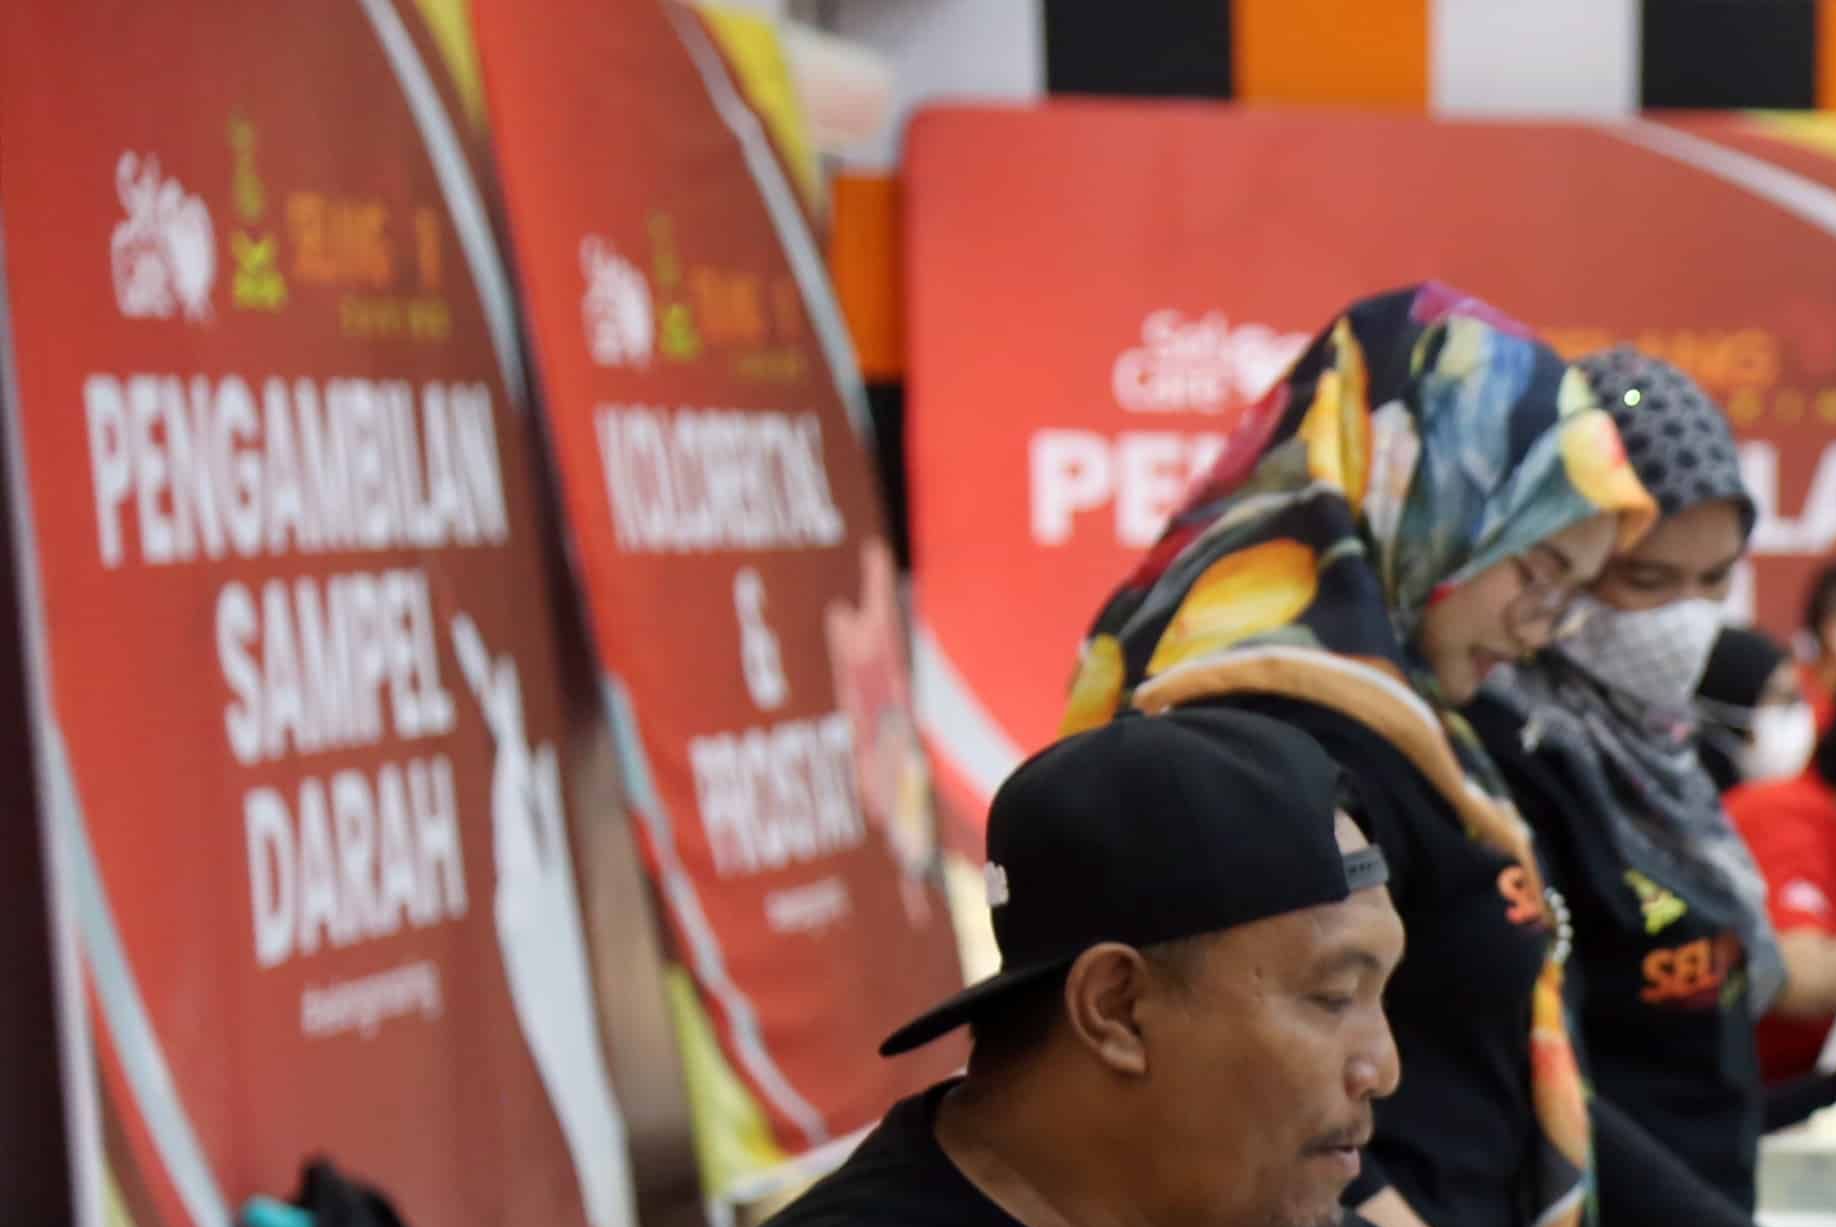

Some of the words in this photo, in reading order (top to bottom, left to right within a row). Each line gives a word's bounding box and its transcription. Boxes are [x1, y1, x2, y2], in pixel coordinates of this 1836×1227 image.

[84, 373, 508, 567] PENGAMBILAN
[216, 568, 455, 766] SAMPEL
[733, 566, 787, 711] &
[243, 755, 468, 968] DARAH
